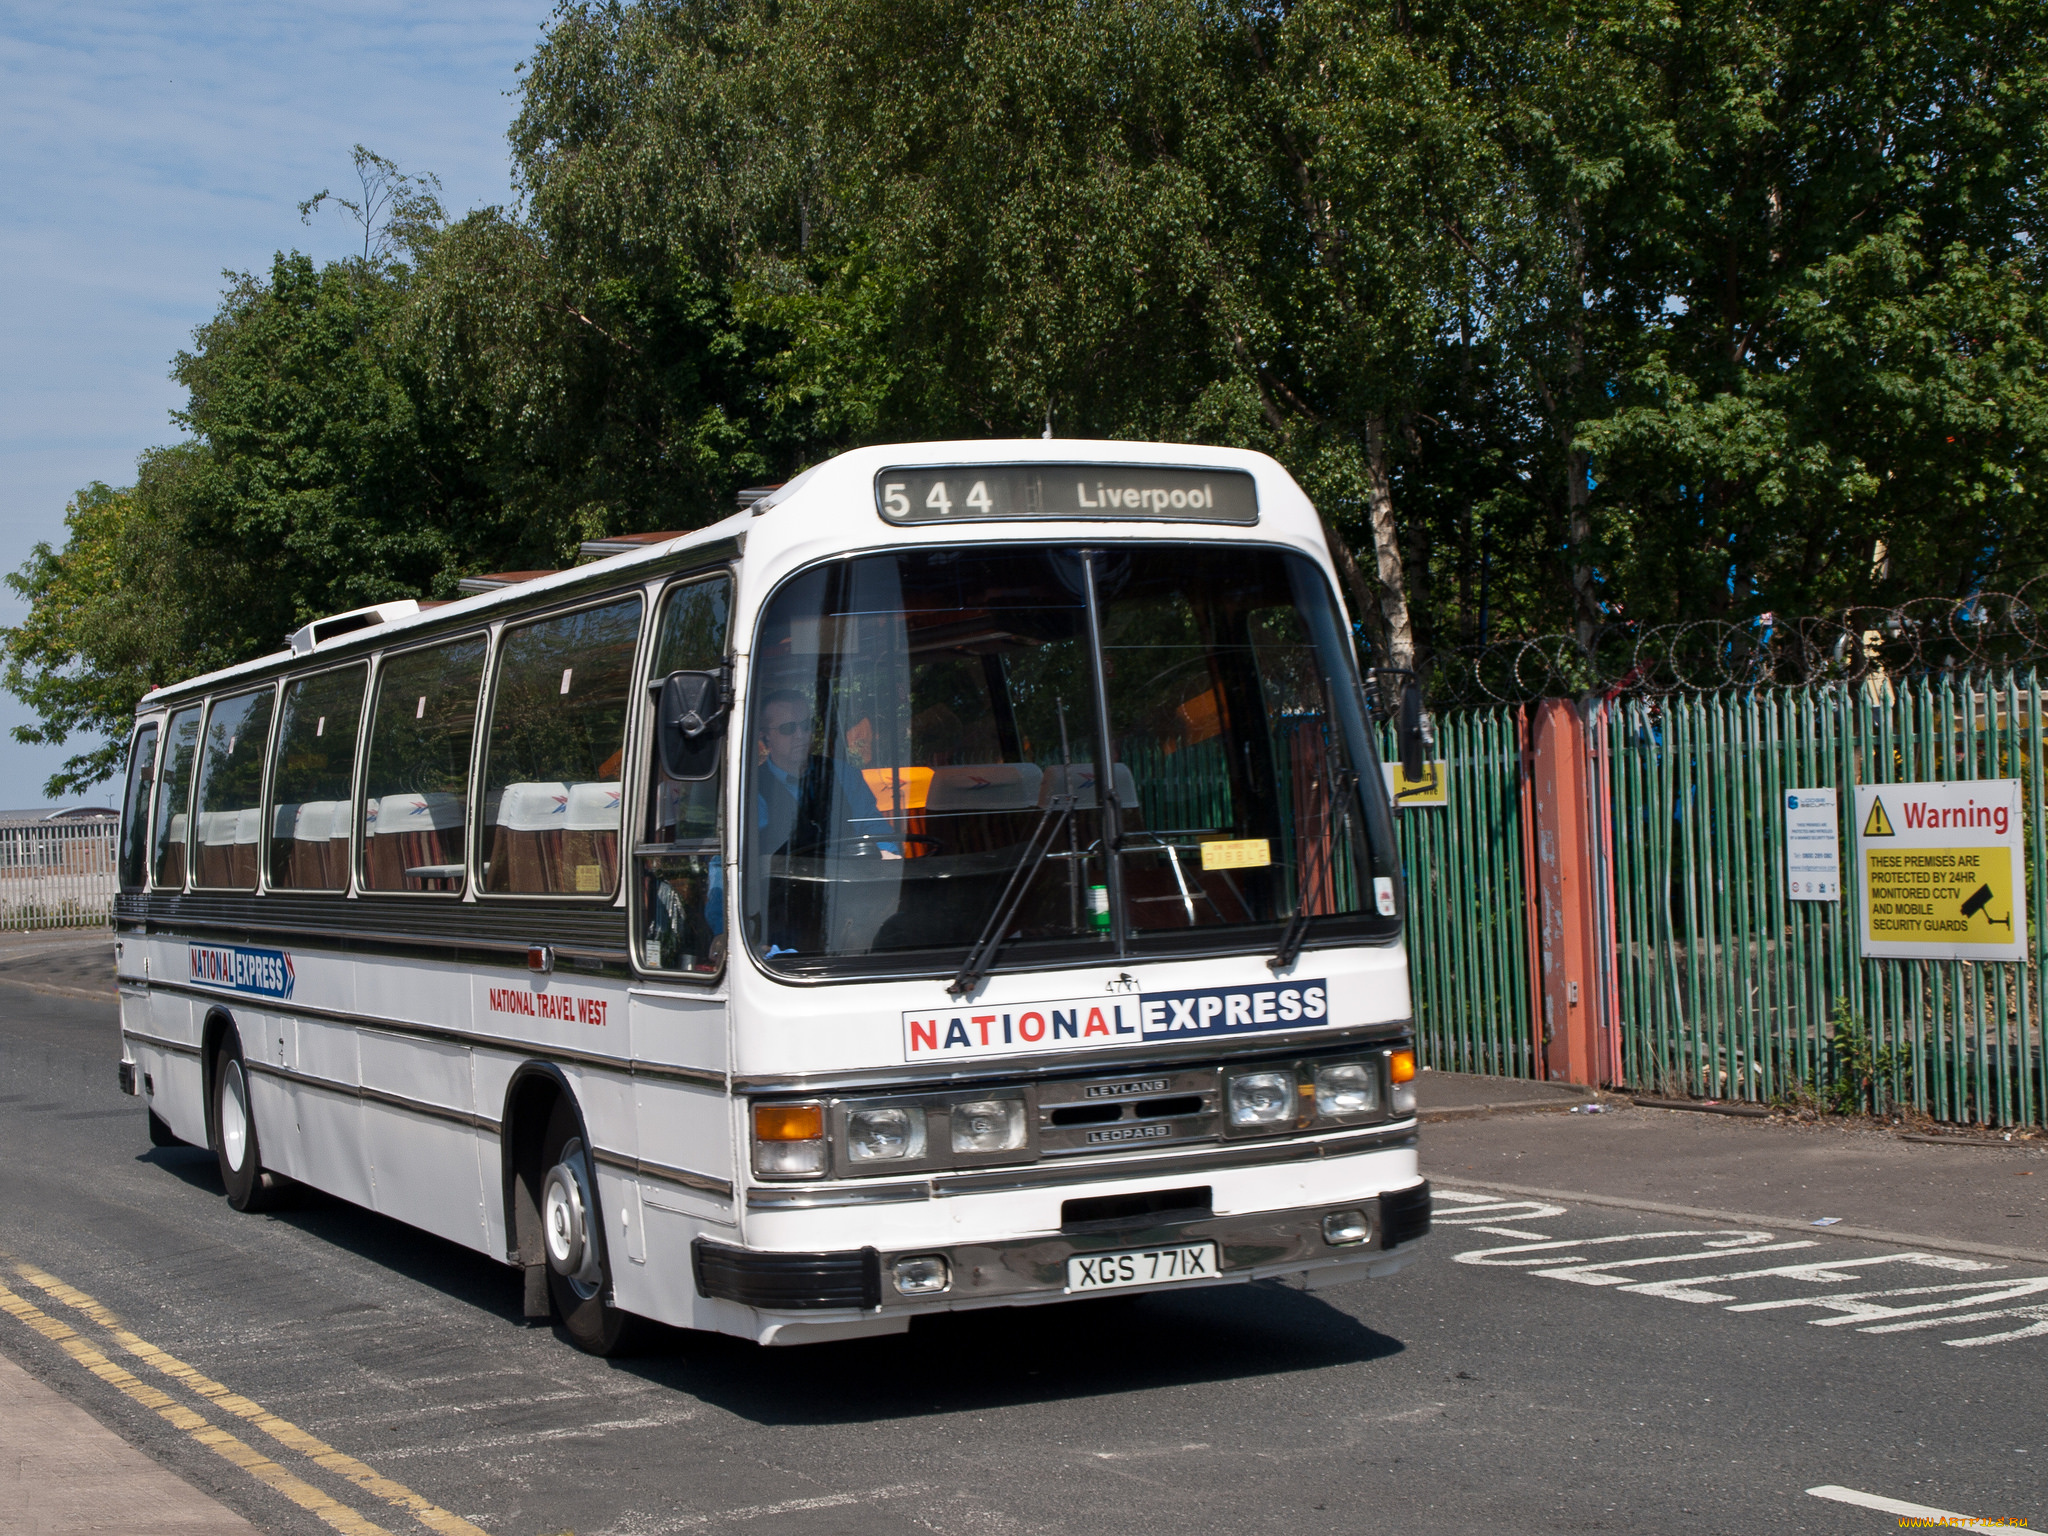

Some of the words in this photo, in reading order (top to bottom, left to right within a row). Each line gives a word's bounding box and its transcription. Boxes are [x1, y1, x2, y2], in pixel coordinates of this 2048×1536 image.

[1077, 482, 1214, 513] Liverpool
[1903, 799, 2009, 835] Warning
[1870, 856, 1903, 868] THESE
[1904, 855, 1956, 867] PREMISES
[1958, 855, 1980, 867] ARE
[1871, 871, 1930, 884] PROTECTED
[1933, 872, 1948, 883] BY
[1949, 871, 1976, 883] 24HR
[1872, 888, 1931, 899] MONITORED
[1932, 887, 1961, 899] CCTV
[1873, 904, 1894, 915] AND
[1895, 904, 1933, 915] MOBILE
[1873, 919, 1922, 931] SECURITY
[1924, 919, 1968, 931] GUARDS
[191, 948, 234, 983] NATIONAL
[236, 953, 284, 991] EXPRESS
[489, 988, 535, 1016] NATIONAL
[537, 993, 576, 1022] TRAVEL
[577, 998, 607, 1026] WEST
[909, 1009, 1136, 1052] NATIONAL
[1141, 986, 1328, 1034] EXPRESS
[1089, 1081, 1166, 1097] LEYLAND
[1090, 1126, 1167, 1142] LEOPARD
[1079, 1255, 1135, 1287] XGS
[1143, 1247, 1205, 1279] 771X
